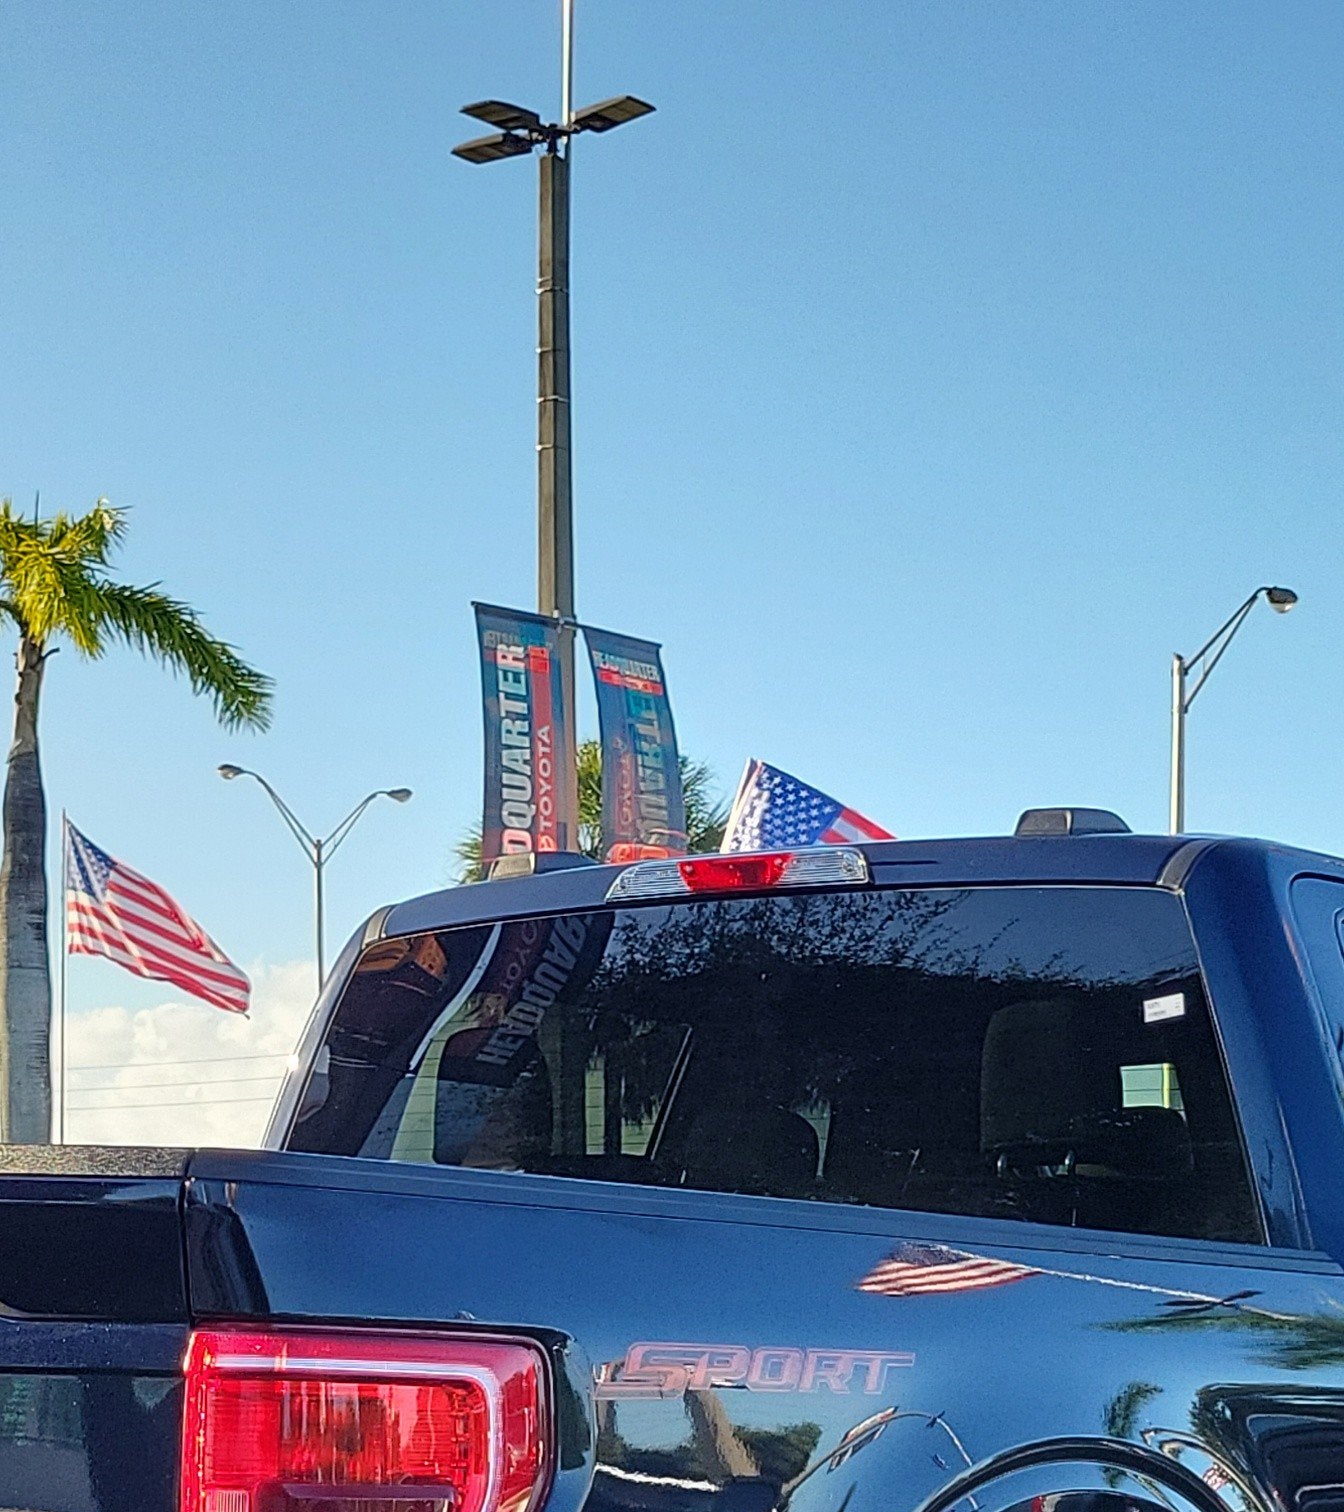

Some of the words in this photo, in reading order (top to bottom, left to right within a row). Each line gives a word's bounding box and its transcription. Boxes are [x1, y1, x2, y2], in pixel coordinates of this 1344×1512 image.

[497, 643, 536, 854] DQUARTER
[536, 724, 557, 834] TOYOTA
[593, 1340, 916, 1400] SPORT
